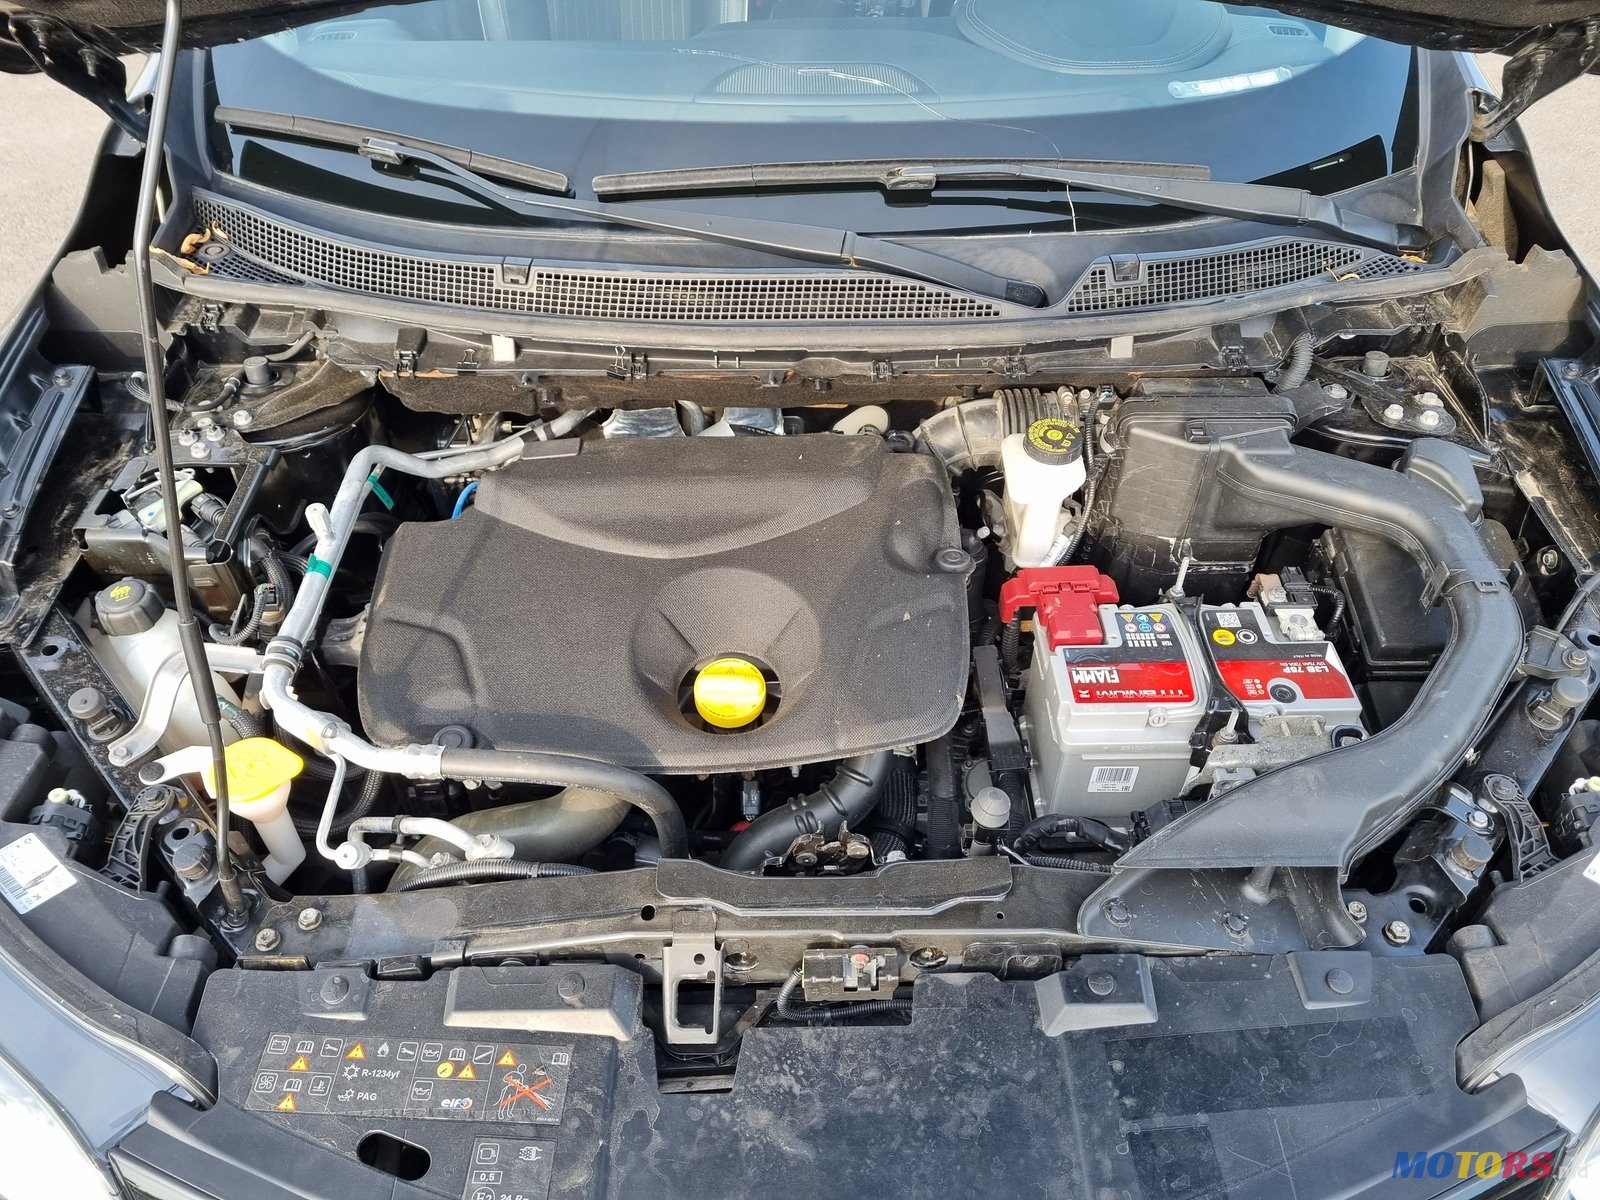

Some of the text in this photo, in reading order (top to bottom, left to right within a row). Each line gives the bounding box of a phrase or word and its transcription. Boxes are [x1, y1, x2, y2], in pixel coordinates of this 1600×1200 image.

[1071, 669, 1120, 684] FIAMM
[361, 1068, 401, 1080] R-1234yf
[356, 1092, 378, 1101] PAG
[440, 1098, 462, 1108] elf
[479, 1172, 495, 1182] 0,5
